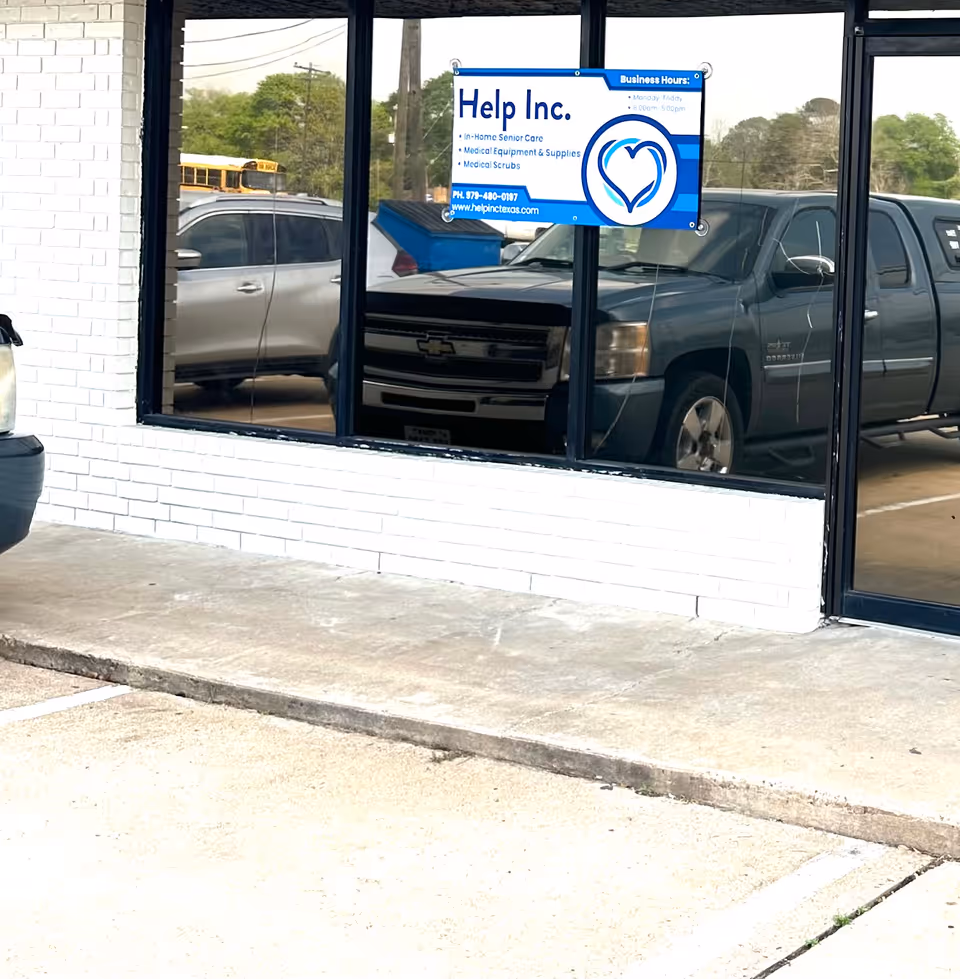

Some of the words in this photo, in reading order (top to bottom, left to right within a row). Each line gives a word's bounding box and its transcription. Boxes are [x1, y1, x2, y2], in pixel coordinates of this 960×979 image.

[620, 74, 660, 84] Business
[661, 75, 690, 85] Hours:
[459, 88, 516, 131] Help
[526, 88, 572, 121] Inc.
[463, 133, 497, 141] In-Home
[498, 134, 524, 142] Senior
[524, 134, 544, 143] Care
[463, 146, 493, 155] Medical
[493, 147, 537, 157] Equipment
[538, 148, 544, 157] &
[546, 149, 581, 159] Supplies
[463, 160, 492, 169] Medical
[493, 160, 521, 170] Scrubs
[452, 191, 465, 199] PH.
[451, 203, 540, 214] www.helpinctexas.com
